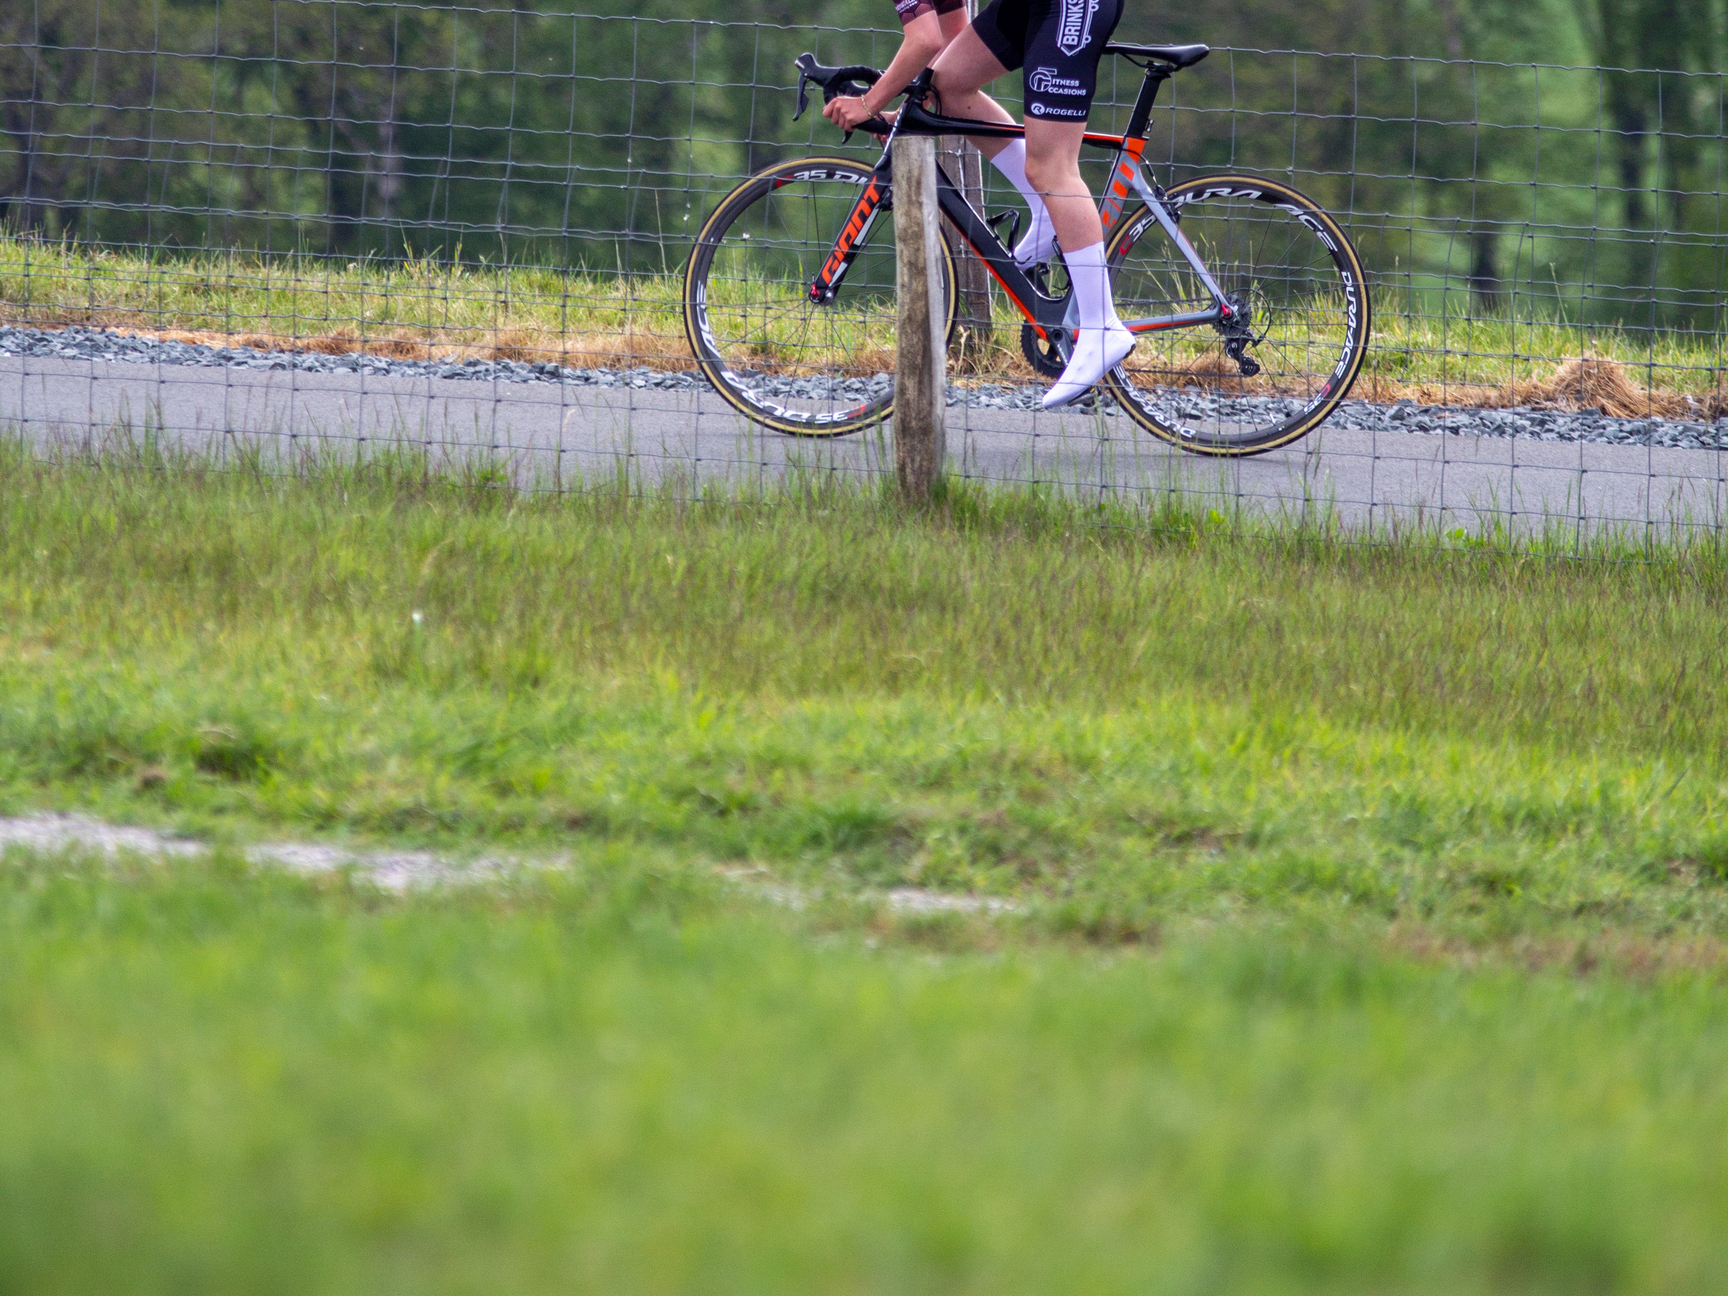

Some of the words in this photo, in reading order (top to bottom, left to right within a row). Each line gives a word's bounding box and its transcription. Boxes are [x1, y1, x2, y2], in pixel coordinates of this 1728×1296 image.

[1045, 107, 1087, 117] ROGELLI
[821, 175, 880, 285] GIANT
[1118, 212, 1158, 256] C35
[1341, 271, 1358, 379] DURA-ACE
